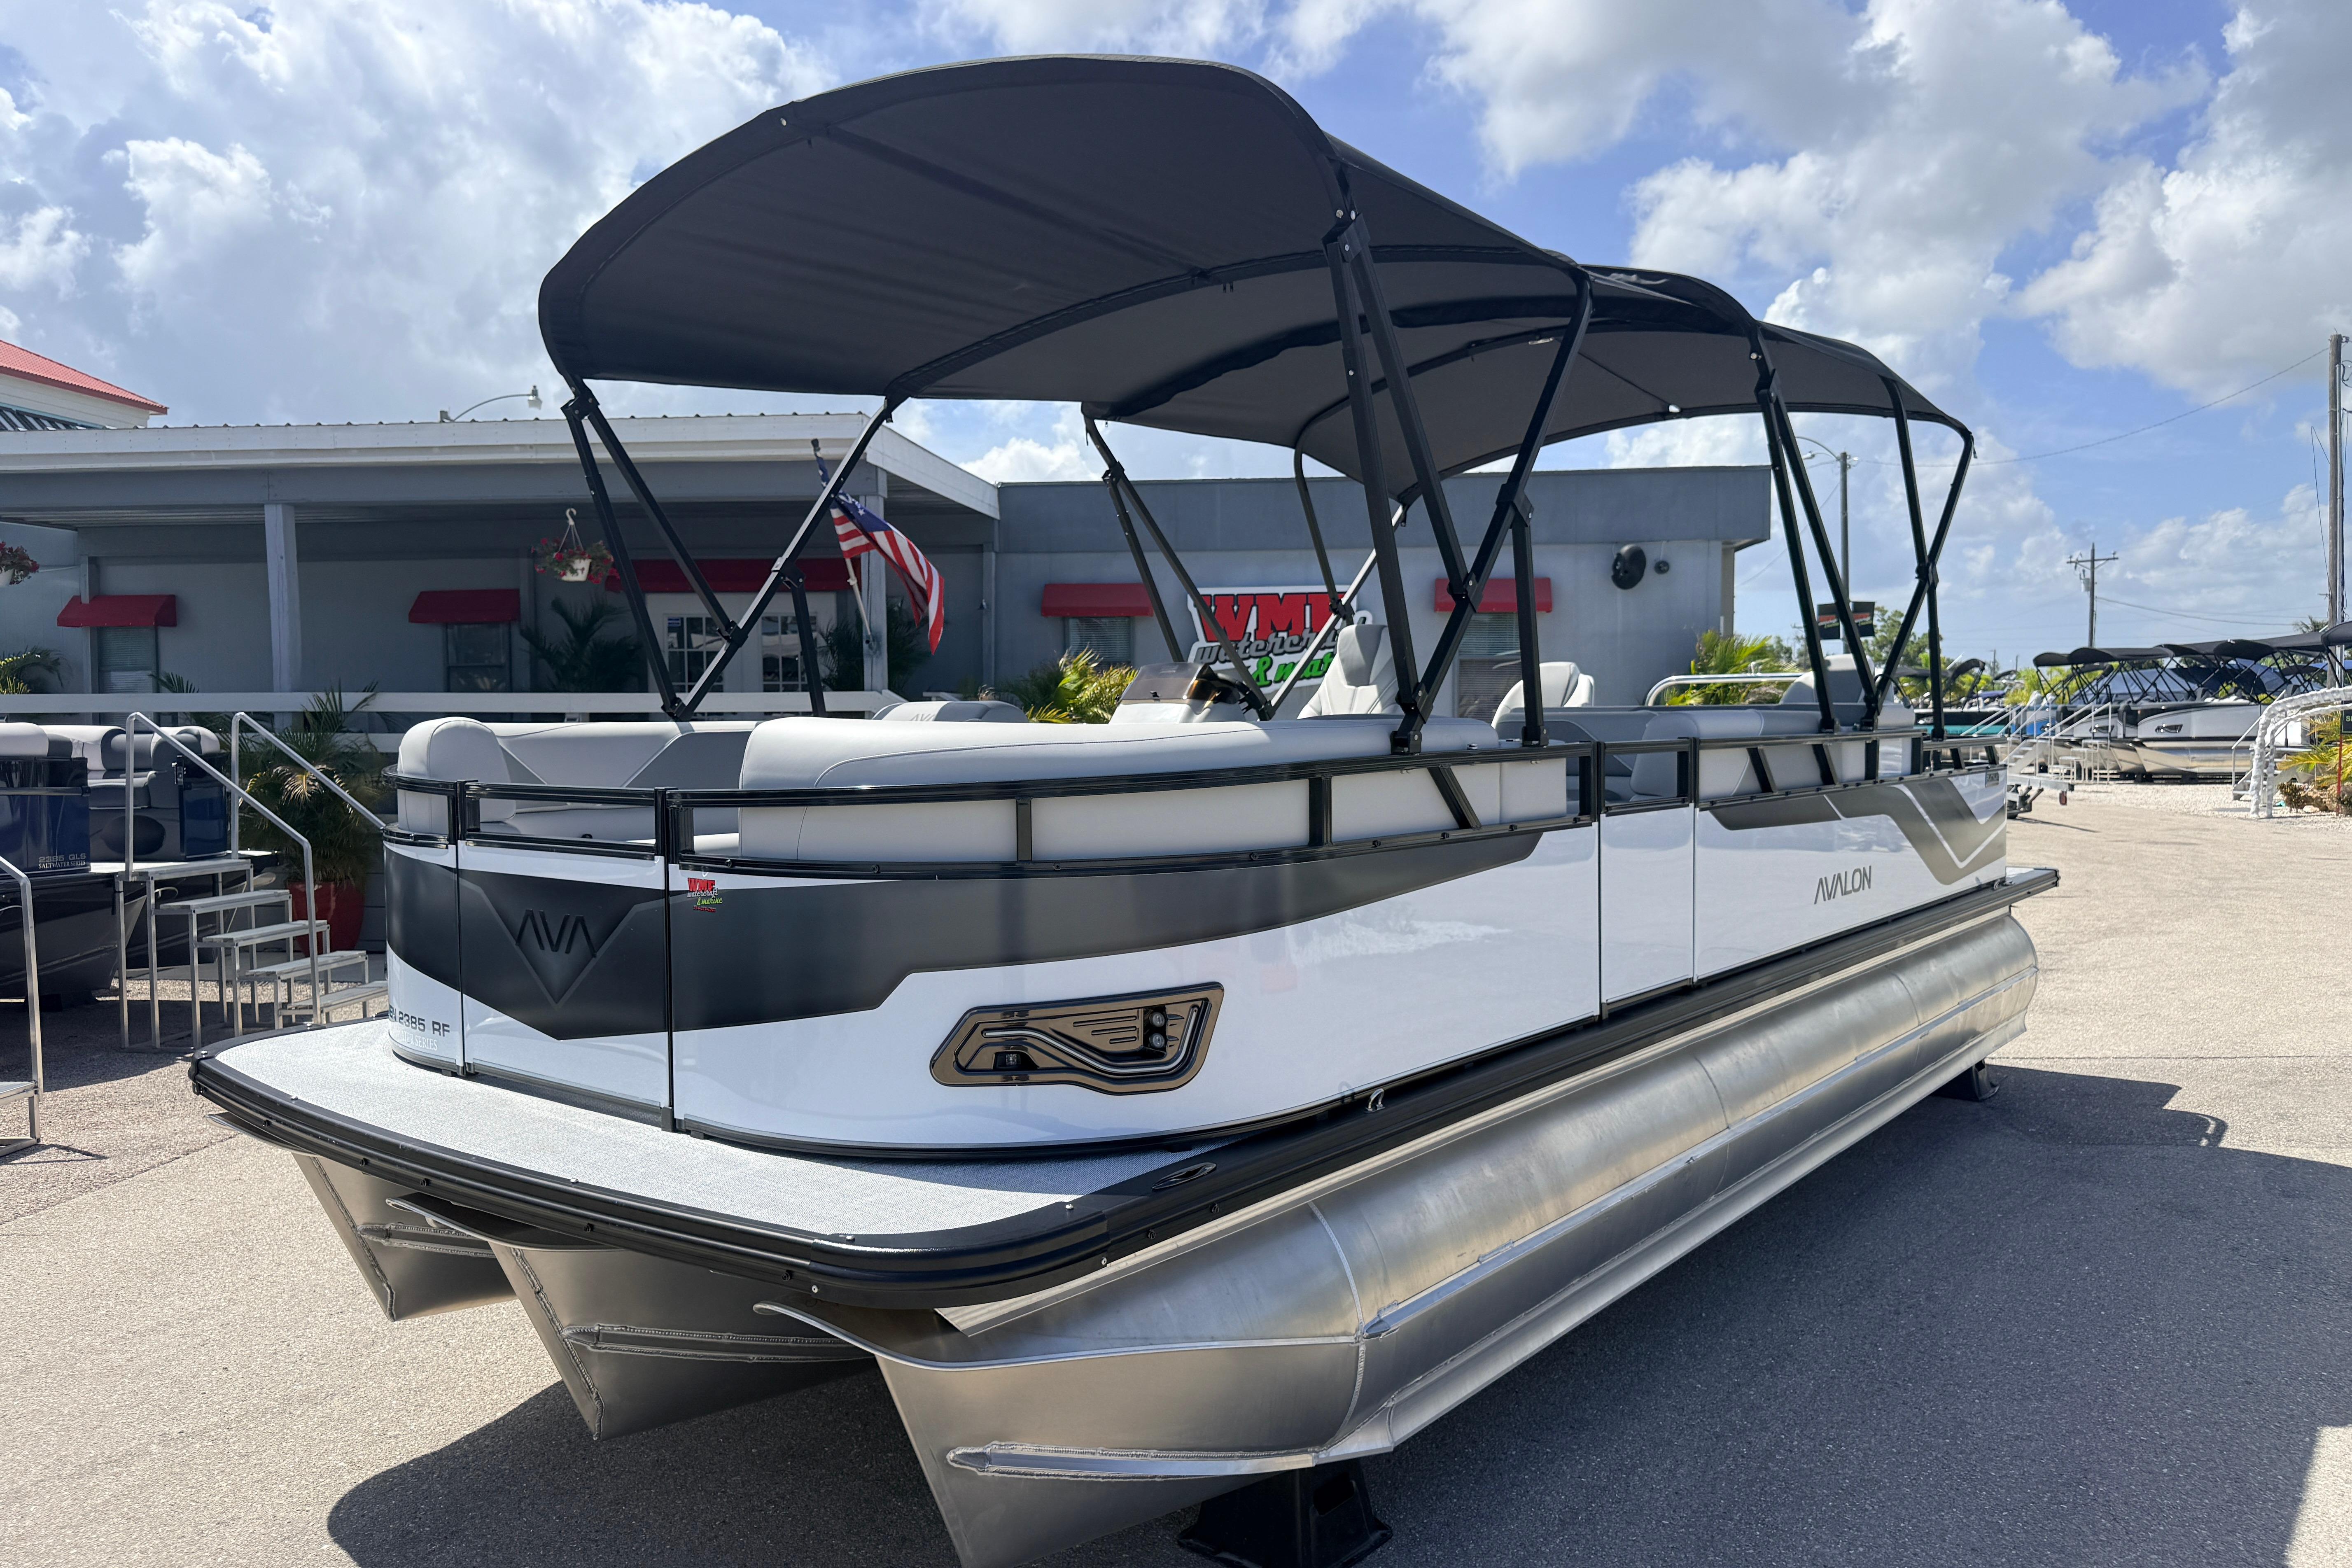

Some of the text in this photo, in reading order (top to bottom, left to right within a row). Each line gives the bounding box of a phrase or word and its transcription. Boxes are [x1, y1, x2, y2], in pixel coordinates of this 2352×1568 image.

[1250, 656, 1273, 687] &
[38, 861, 70, 869] SALTWATER
[688, 877, 715, 892] WMF
[1814, 865, 1871, 904] AVALON
[687, 888, 718, 898] watercraft
[701, 896, 723, 905] marine
[515, 909, 597, 958] AVA
[399, 1011, 425, 1032] 2385
[432, 1020, 450, 1037] RF
[415, 1035, 438, 1051] SERIES
